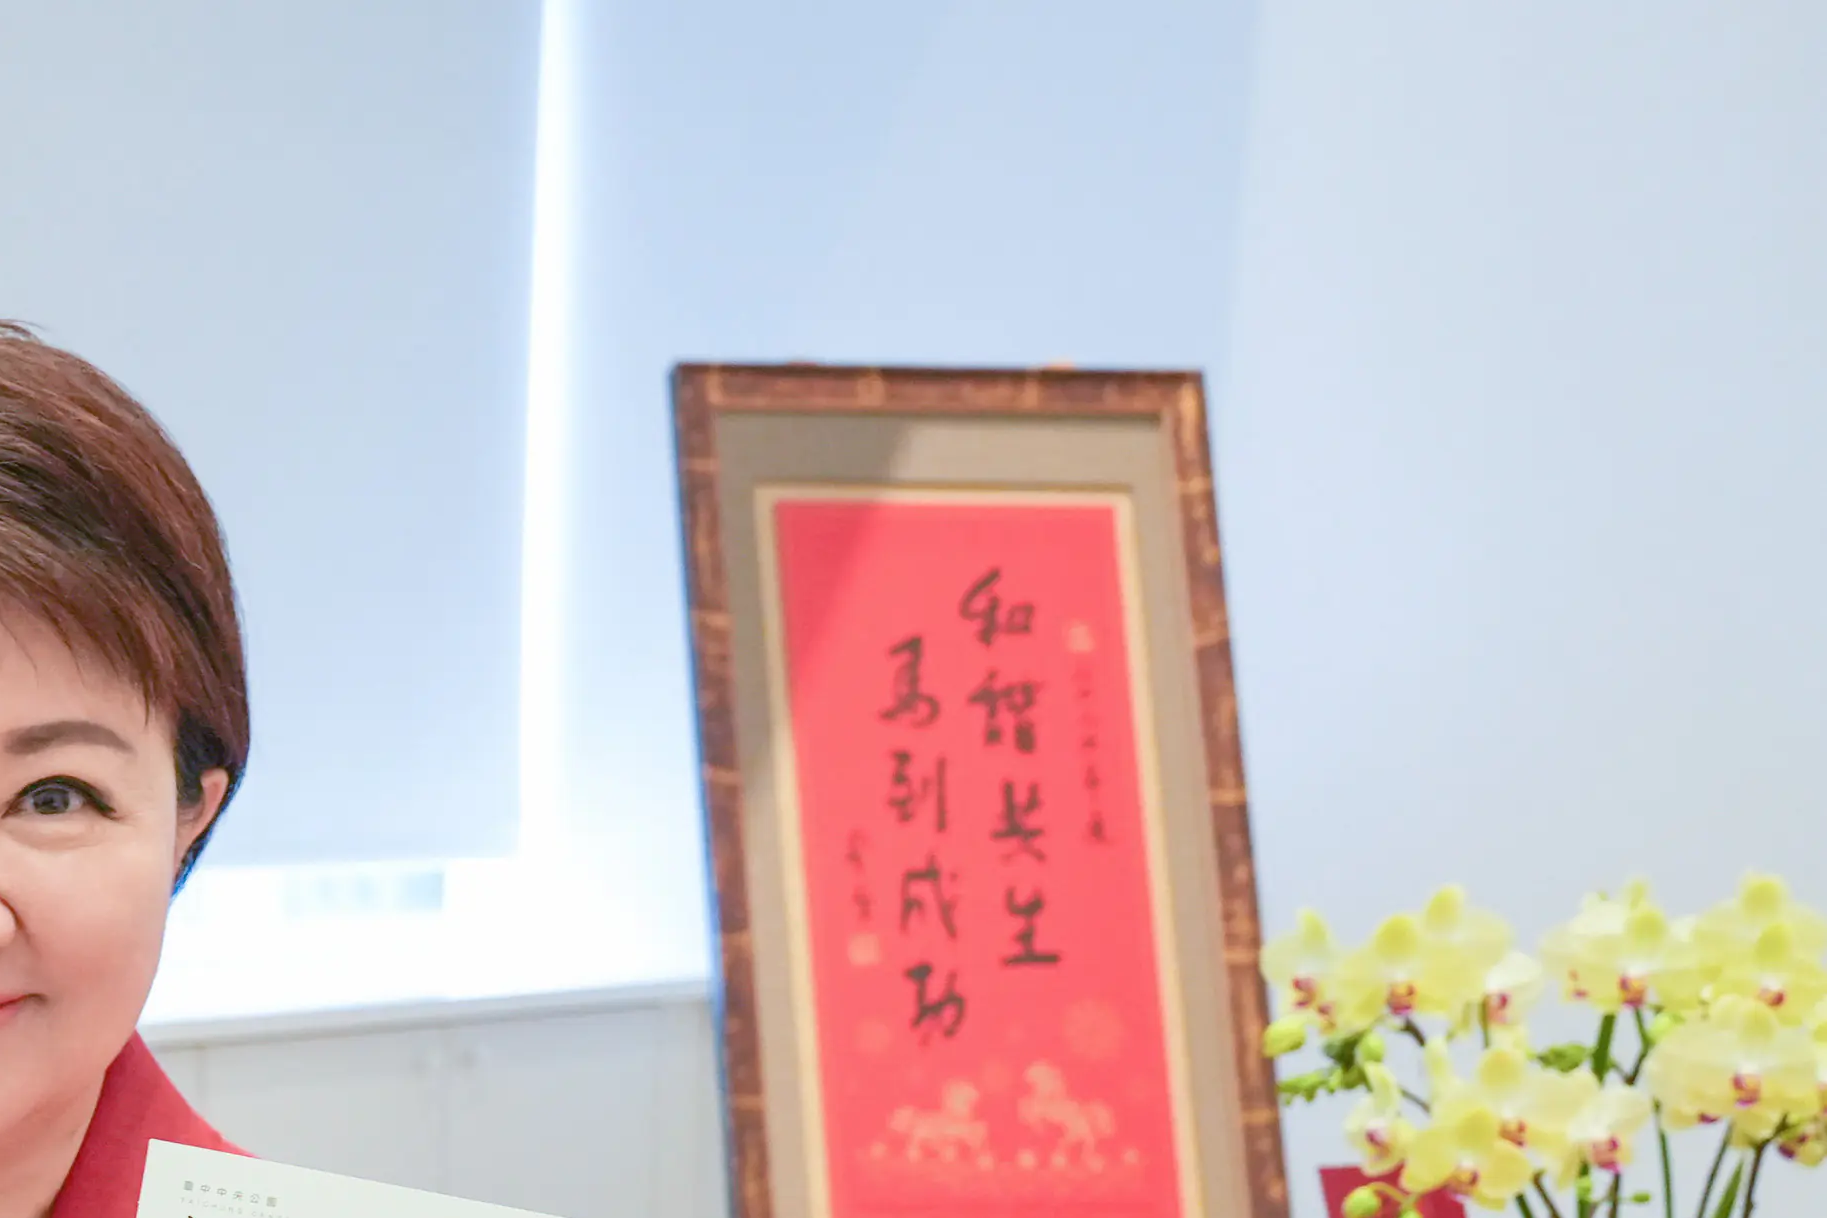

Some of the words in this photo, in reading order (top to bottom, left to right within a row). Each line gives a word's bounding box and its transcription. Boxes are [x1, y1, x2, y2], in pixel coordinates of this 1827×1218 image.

[878, 635, 966, 1042] 馬到成功
[959, 567, 1061, 966] 和諧共生
